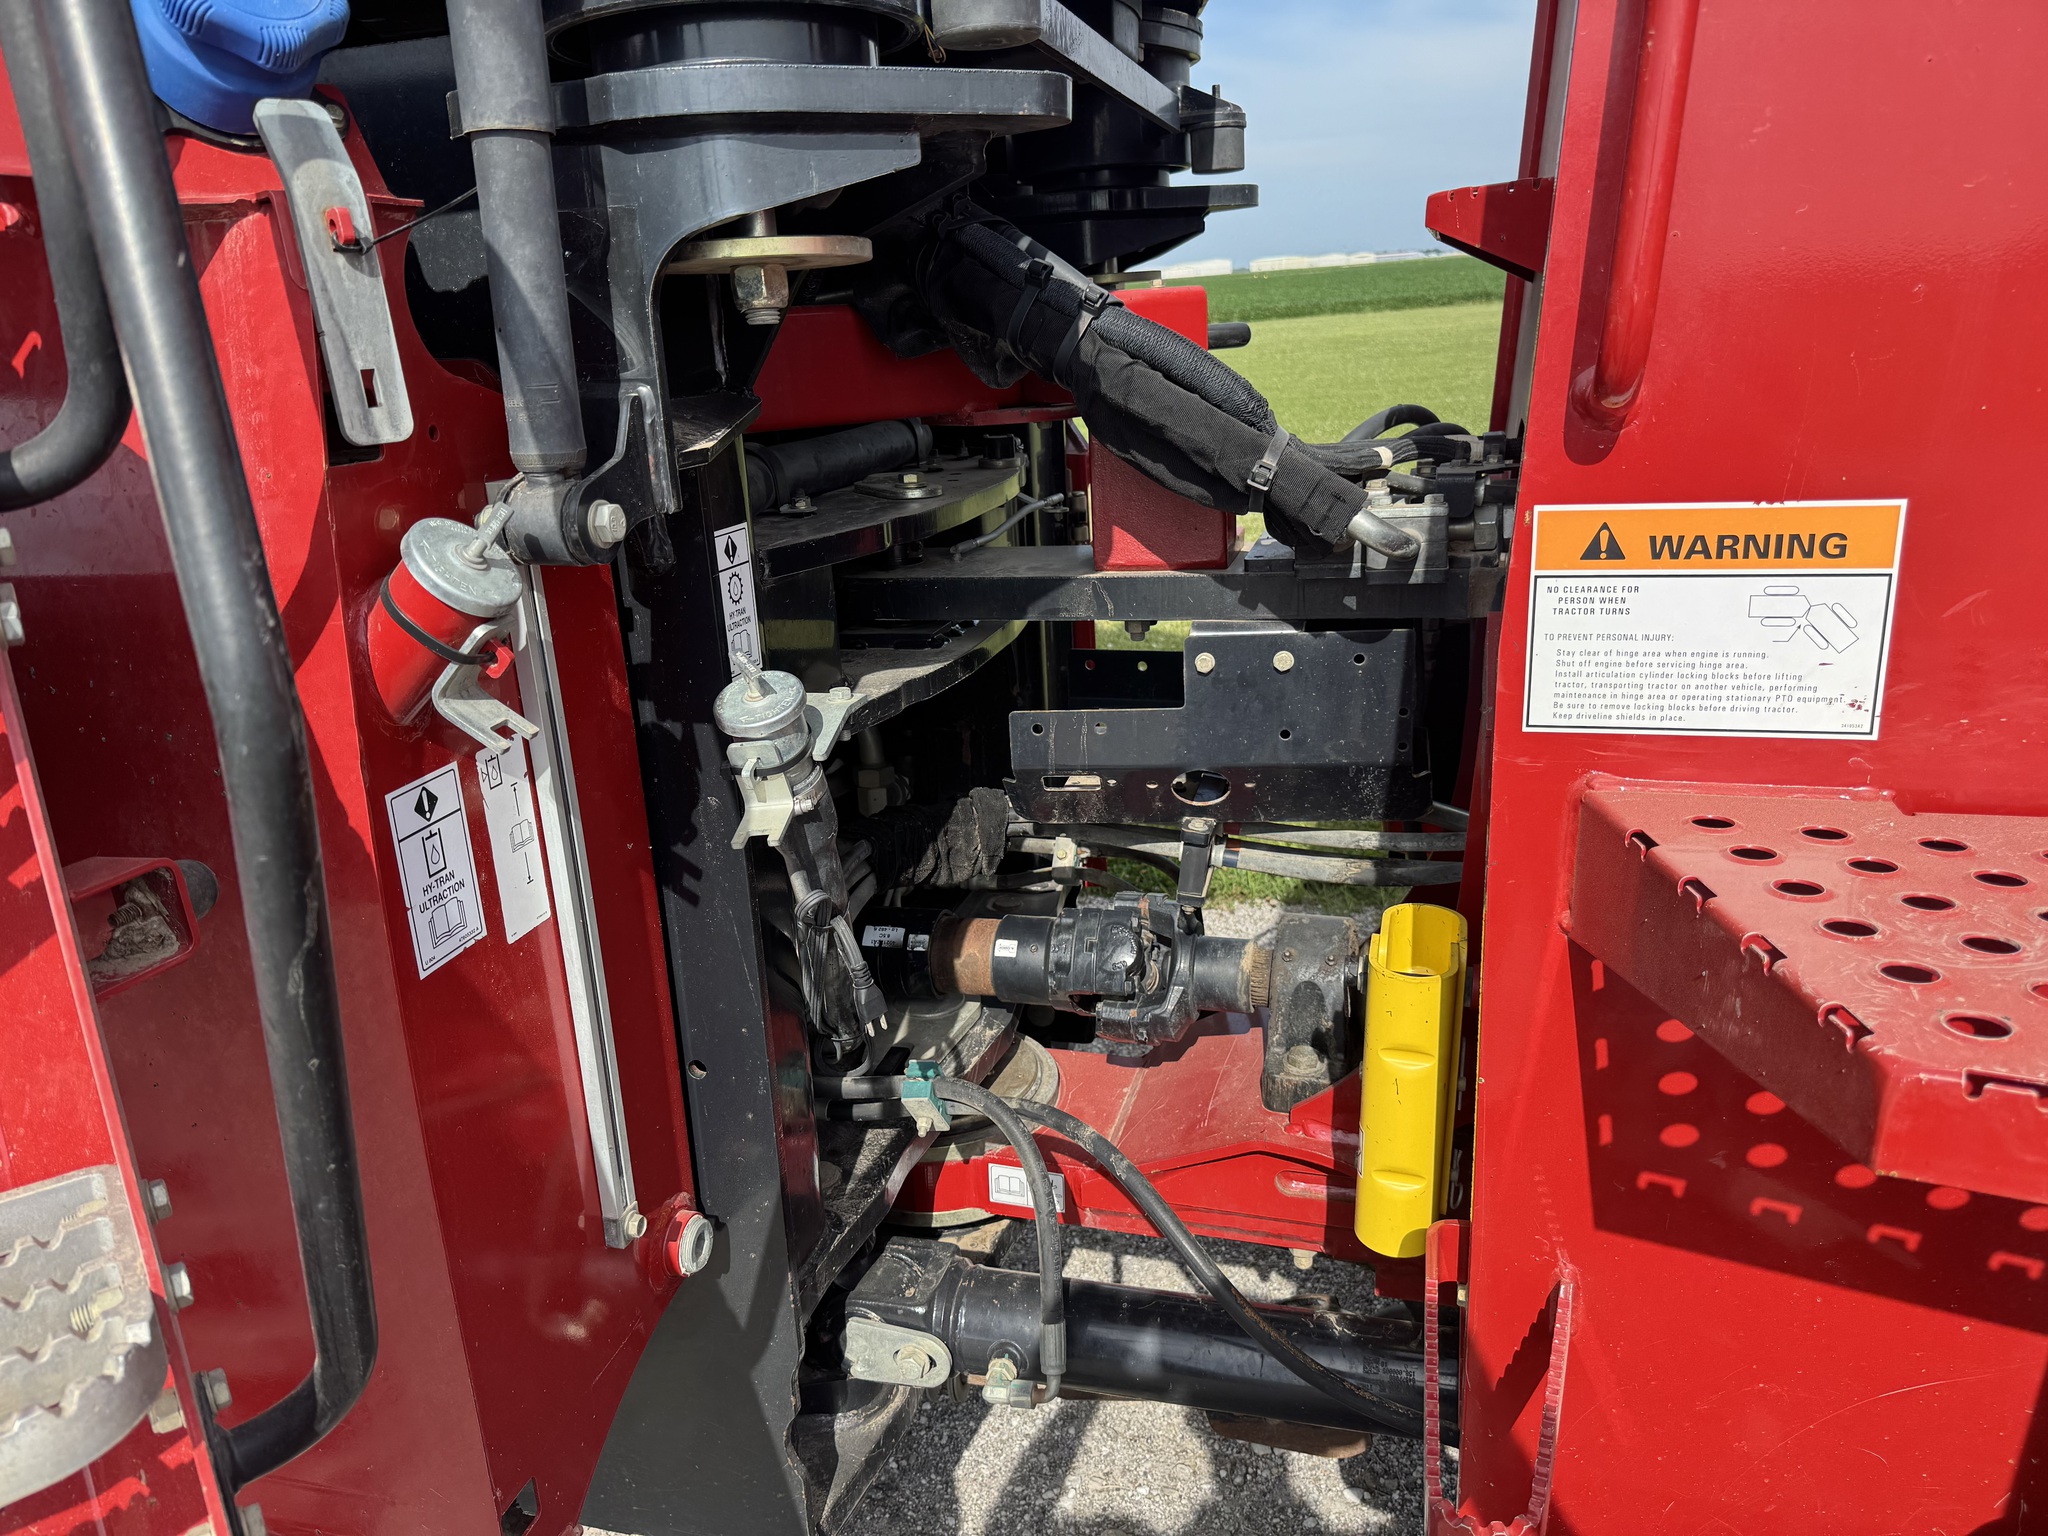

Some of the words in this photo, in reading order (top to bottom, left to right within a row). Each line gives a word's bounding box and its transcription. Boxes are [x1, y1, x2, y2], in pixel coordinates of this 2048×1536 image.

[1648, 532, 1848, 560] WARNING
[729, 606, 747, 620] HY-TRAN
[727, 615, 752, 633] ULTRACTION
[1556, 649, 1575, 657] Stay
[1616, 649, 1638, 657] hinge
[1690, 650, 1718, 659] engine
[1733, 651, 1769, 660] running.
[1595, 660, 1622, 669] engine
[1626, 660, 1653, 668] before
[1657, 661, 1695, 670] servicing
[1699, 661, 1722, 670] hinge
[1555, 670, 1582, 678] Install
[1639, 671, 1673, 680] cylinder
[1677, 672, 1708, 681] locking
[1711, 672, 1739, 680] blocks
[1743, 672, 1771, 680] before
[1775, 673, 1803, 682] lifting
[1555, 681, 1587, 689] tractor,
[1591, 681, 1644, 690] transporting
[1731, 684, 1765, 692] vehicle,
[1769, 684, 1818, 693] performing
[1621, 692, 1644, 700] hinge
[1681, 694, 1722, 702] operating
[1726, 695, 1771, 703] stationary
[1797, 696, 1846, 704] equipment.
[1634, 703, 1664, 712] locking
[1668, 703, 1695, 711] blocks
[1699, 704, 1726, 712] before
[1730, 705, 1760, 714] driving
[1764, 705, 1798, 713] tractor.
[1553, 712, 1572, 720] Keep
[1576, 712, 1612, 720] driveline
[1616, 712, 1645, 721] shields
[1660, 714, 1685, 722] place.
[422, 869, 455, 897] HY-TRAN
[418, 878, 465, 914] ULTRACTION
